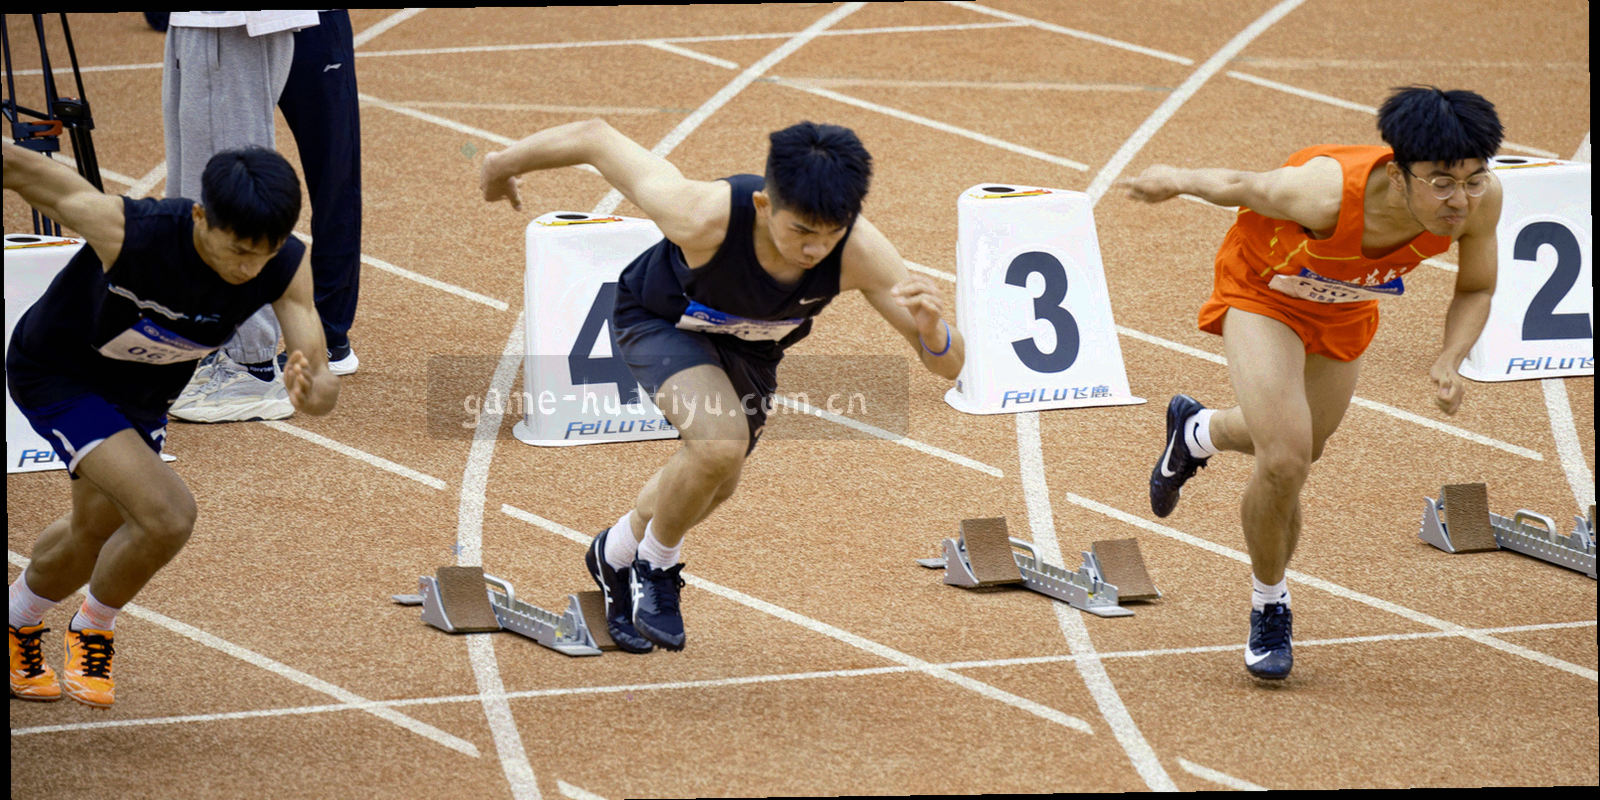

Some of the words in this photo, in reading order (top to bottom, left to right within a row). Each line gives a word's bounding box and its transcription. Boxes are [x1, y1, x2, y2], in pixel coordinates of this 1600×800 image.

[1513, 221, 1593, 341] 2
[1004, 251, 1081, 374] 3
[568, 282, 641, 405] 4
[1506, 356, 1575, 375] FeiLu
[1001, 386, 1068, 409] FeiLu
[564, 419, 636, 440] FeiLu
[18, 449, 61, 468] Fei
